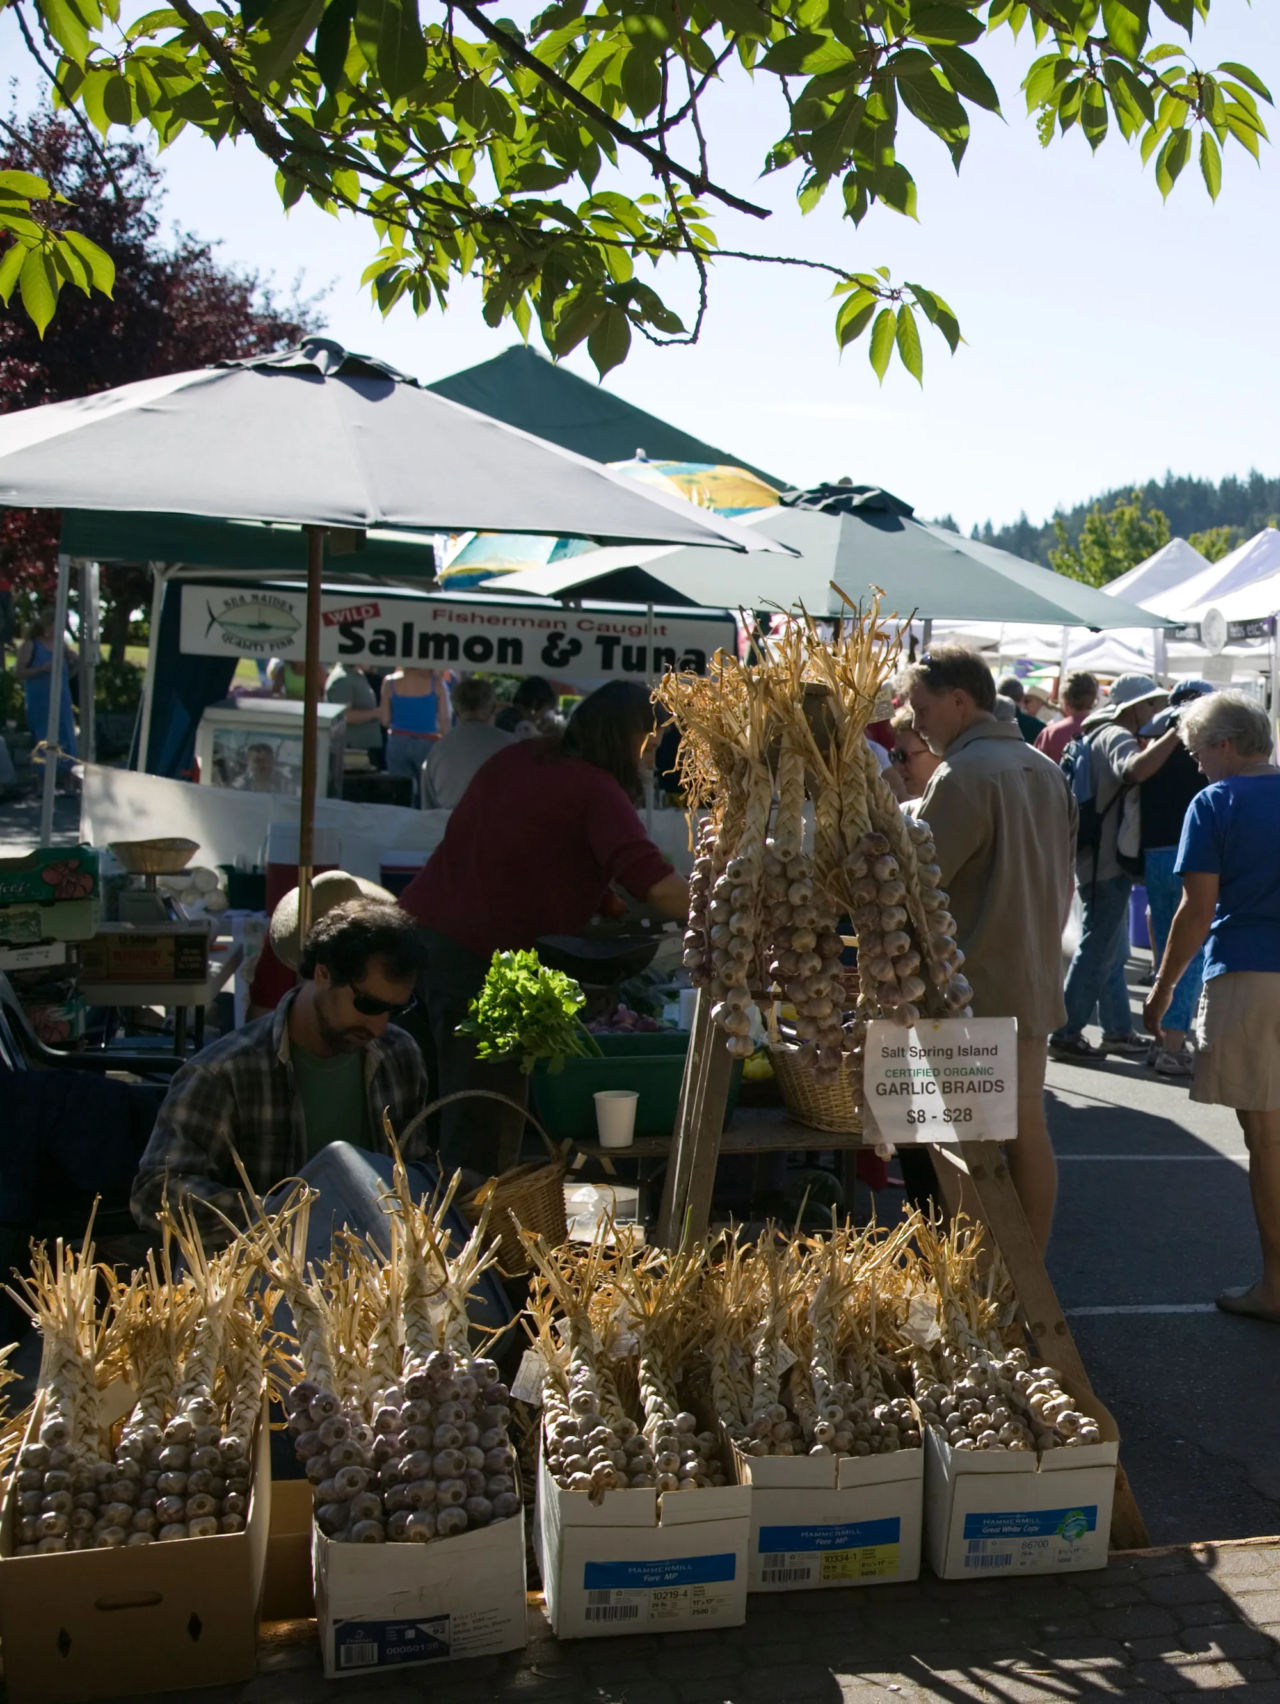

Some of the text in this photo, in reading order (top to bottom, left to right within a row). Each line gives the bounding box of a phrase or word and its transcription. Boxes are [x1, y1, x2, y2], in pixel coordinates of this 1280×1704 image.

[222, 594, 246, 609] SEA
[328, 605, 374, 624] WILD
[432, 608, 668, 637] Fisherman Caught
[221, 632, 295, 652] QUALITY FISH
[337, 620, 706, 675] Salmon & Tuna
[881, 1045, 998, 1060] Salt Spring Island
[885, 1066, 994, 1079] CERTIFIED ORGANIC
[876, 1079, 1005, 1096] GARLIC BRAIDS
[907, 1109, 926, 1125] $8
[943, 1107, 973, 1124] $28
[1023, 1525, 1040, 1533] Copy
[834, 1537, 849, 1545] MP
[1021, 1540, 1049, 1550] 86700
[824, 1553, 857, 1563] 10334-1
[643, 1572, 679, 1582] Fore MP
[652, 1590, 688, 1601] 10219-4
[432, 1627, 445, 1635] 92
